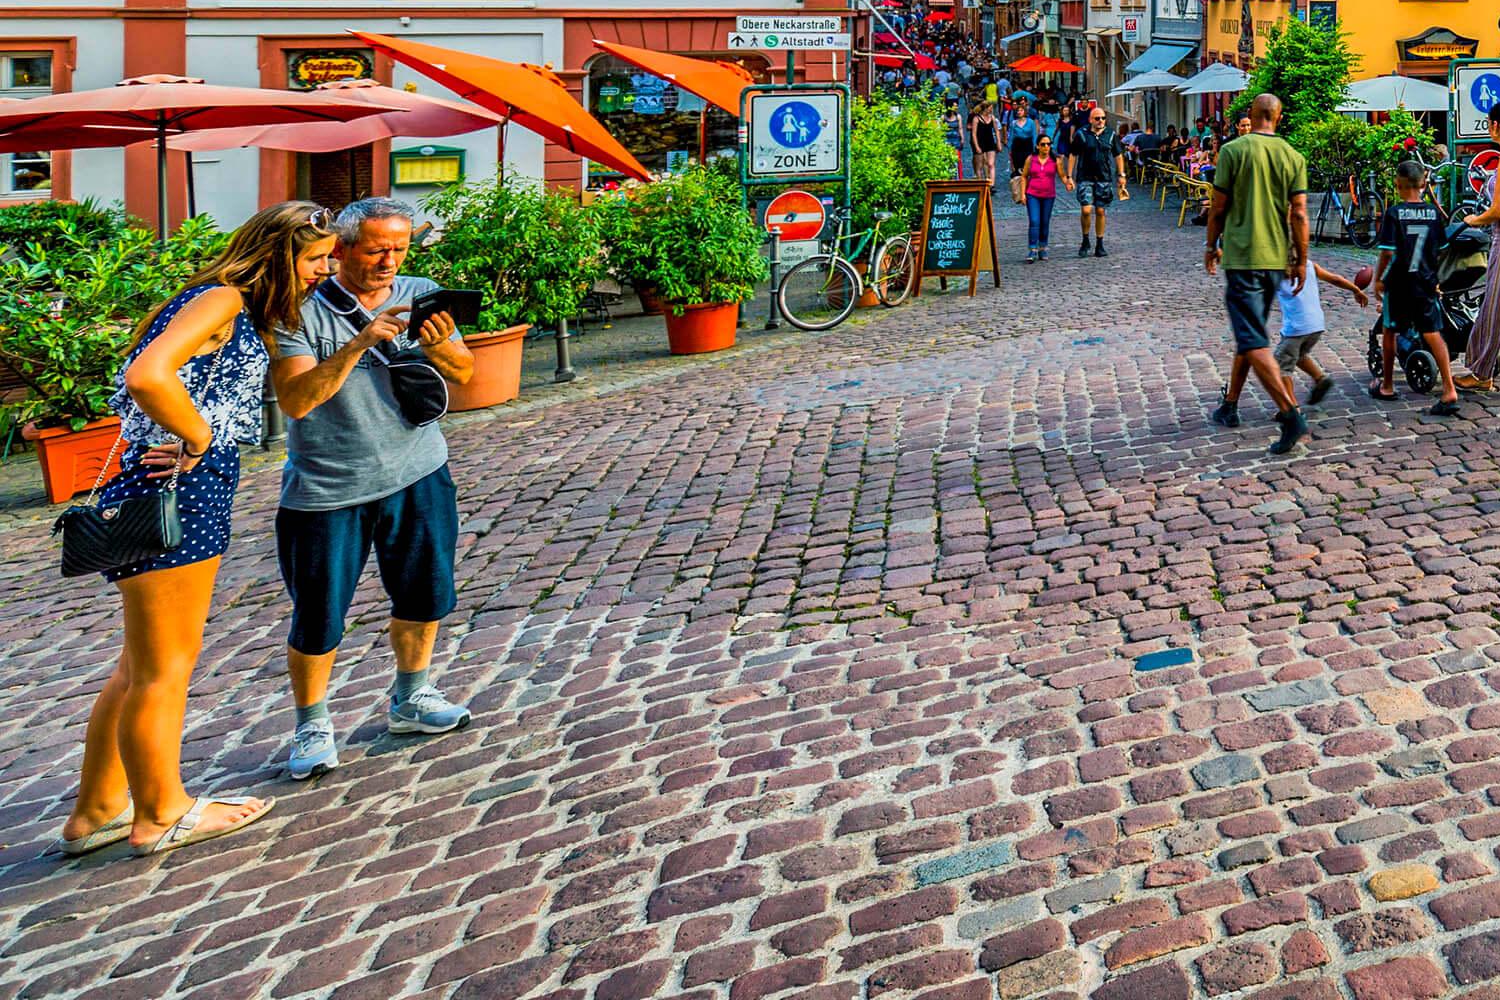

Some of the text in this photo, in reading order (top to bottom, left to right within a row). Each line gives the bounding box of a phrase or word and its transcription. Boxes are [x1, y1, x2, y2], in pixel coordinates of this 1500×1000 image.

[742, 19, 836, 30] Obere Neckarstraße
[781, 37, 825, 47] Altstadt
[1474, 119, 1489, 131] ZO
[773, 154, 817, 169] ZONE
[1398, 208, 1437, 221] RONALDO
[1406, 224, 1430, 273] 7
